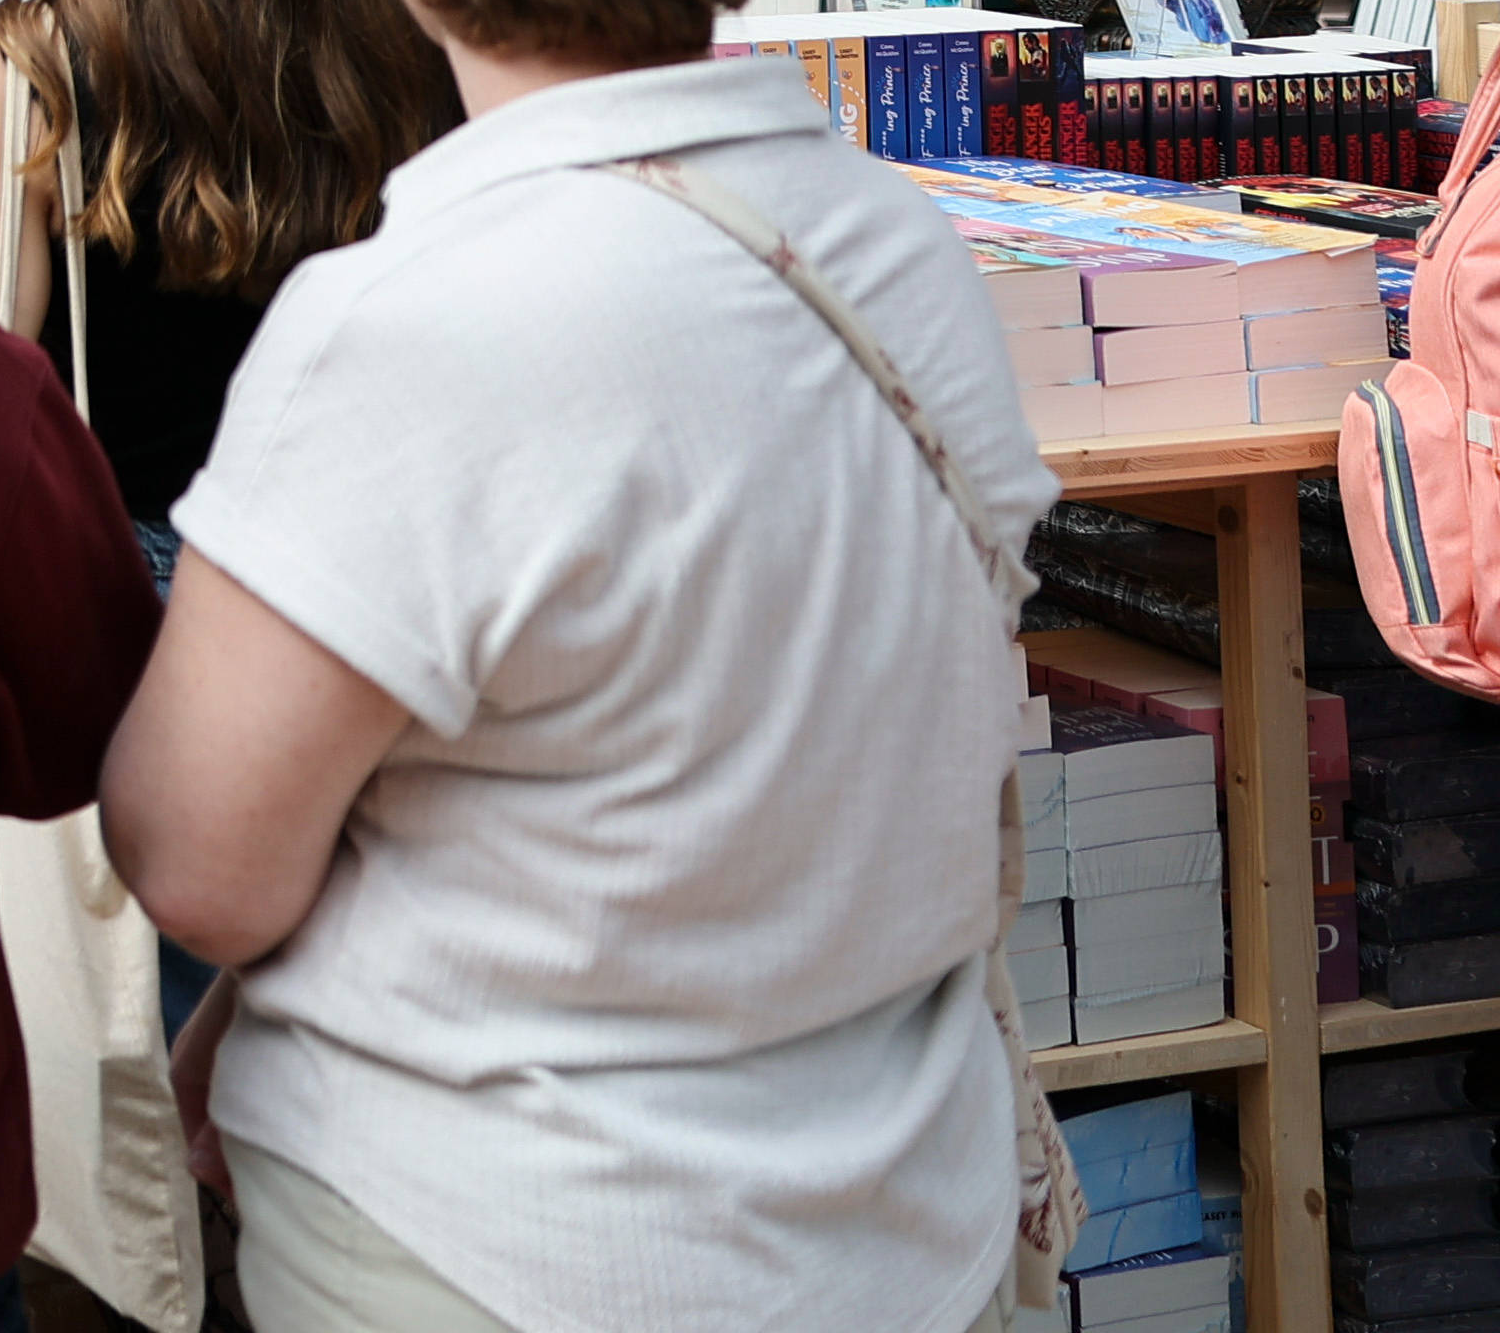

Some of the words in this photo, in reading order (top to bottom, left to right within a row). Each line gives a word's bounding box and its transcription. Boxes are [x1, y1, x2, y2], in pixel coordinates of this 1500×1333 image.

[880, 64, 897, 106] Prince
[919, 63, 933, 104] Prince
[956, 61, 970, 102] Prince
